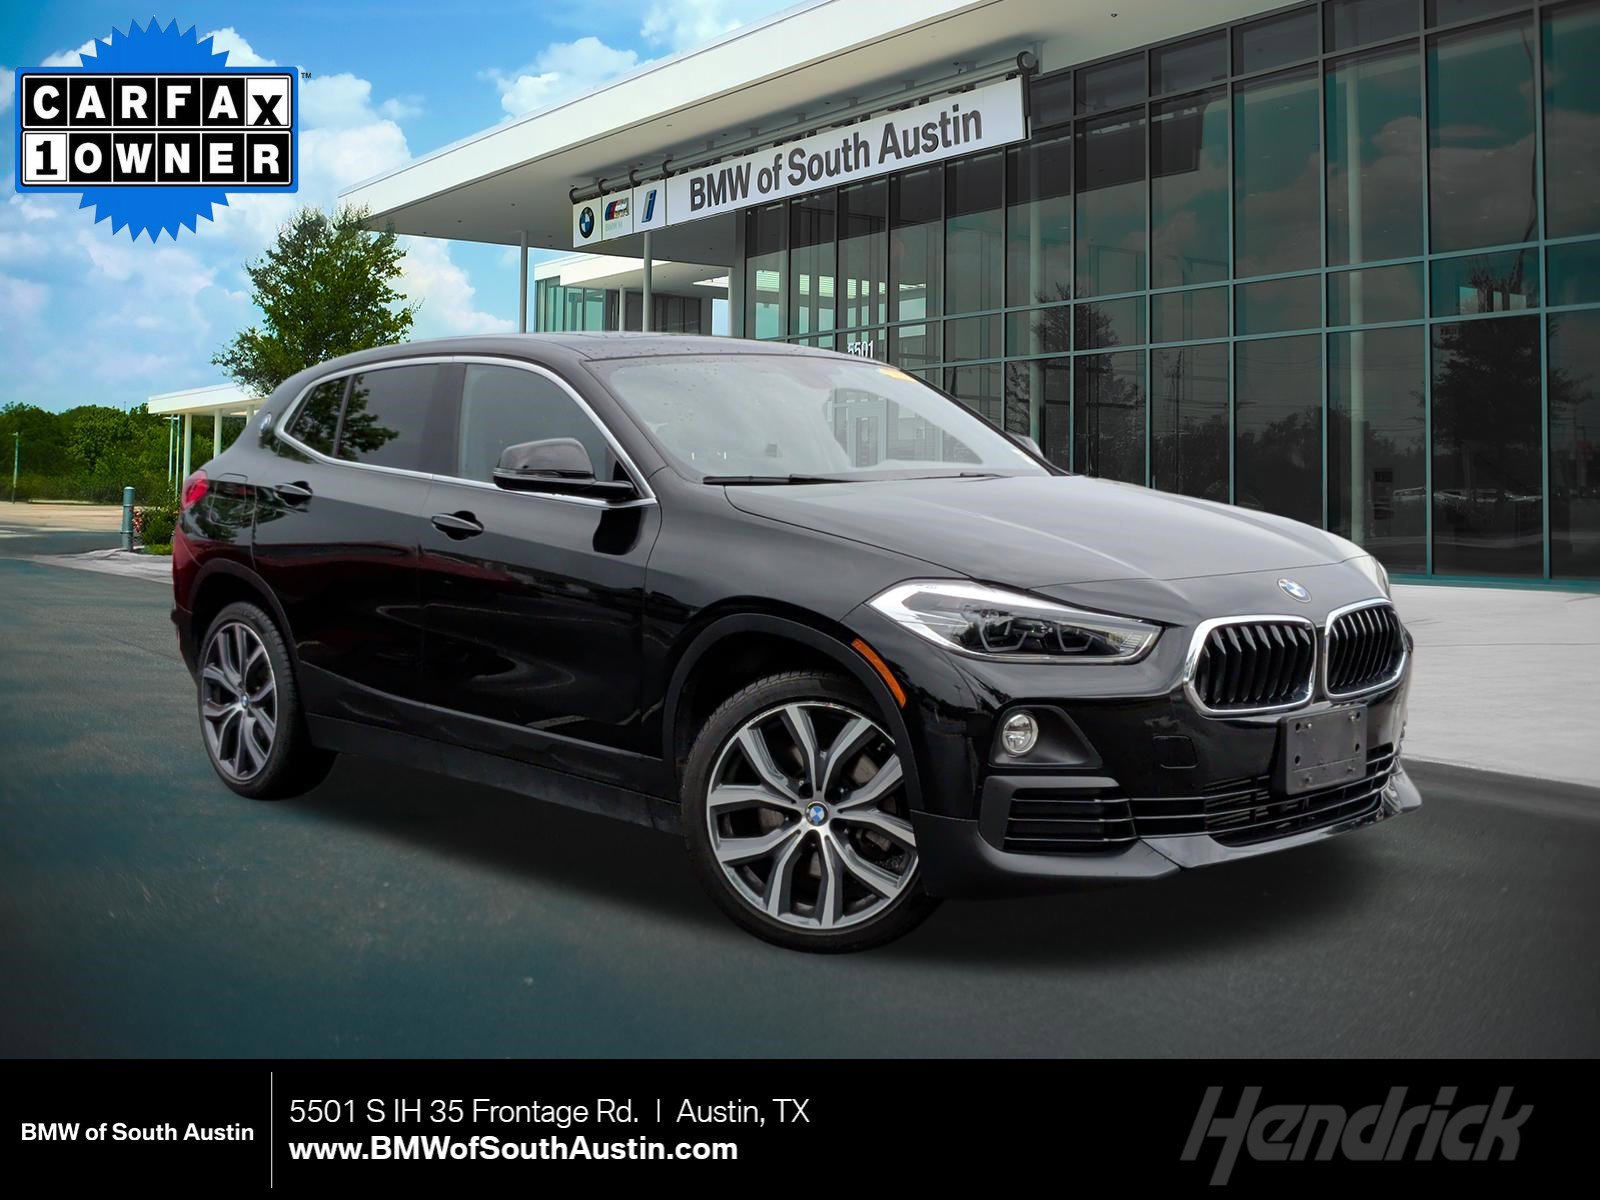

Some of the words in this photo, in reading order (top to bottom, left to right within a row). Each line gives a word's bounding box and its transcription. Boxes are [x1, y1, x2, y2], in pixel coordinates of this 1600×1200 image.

[690, 162, 752, 212] BMW
[757, 153, 783, 194] of
[787, 131, 870, 187] South
[878, 104, 983, 164] Austin
